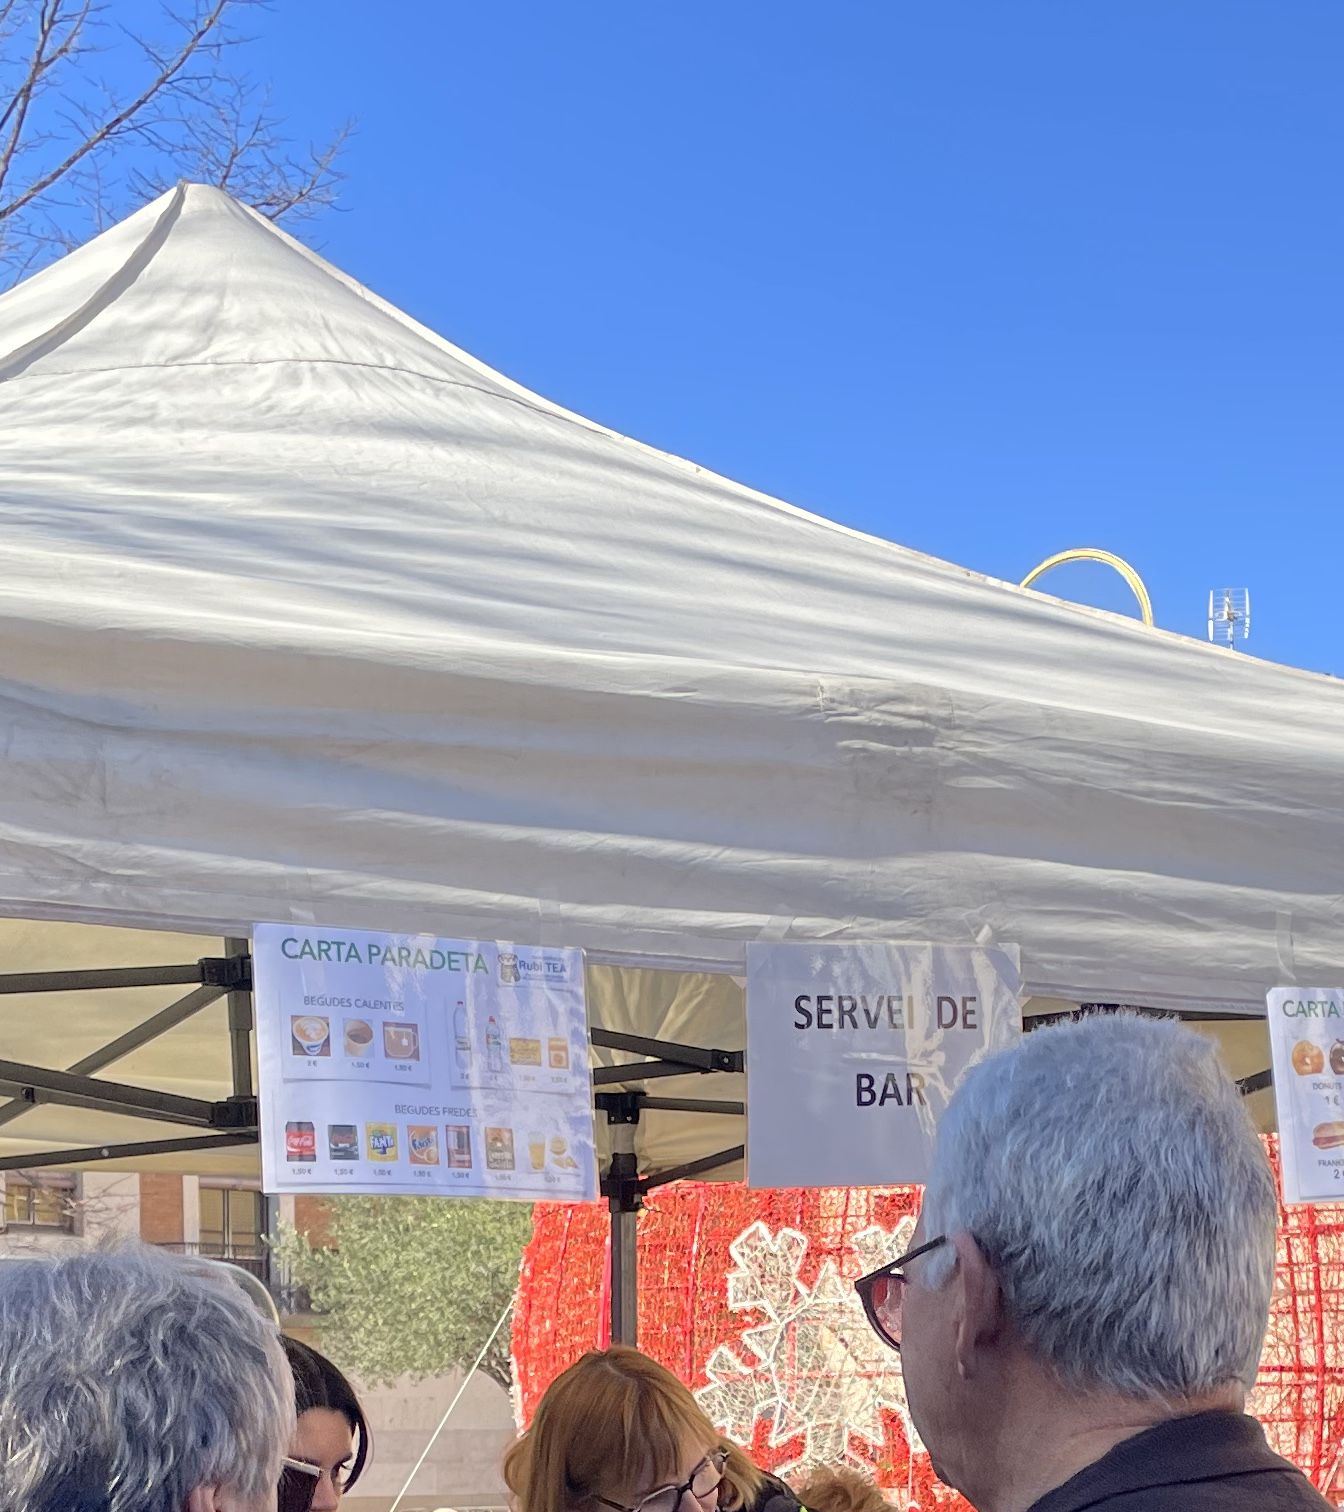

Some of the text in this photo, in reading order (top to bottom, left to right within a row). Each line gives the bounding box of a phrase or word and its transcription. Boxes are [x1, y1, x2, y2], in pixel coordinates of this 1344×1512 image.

[281, 937, 488, 975] CARTA PARADETA
[545, 962, 567, 974] TEA
[303, 995, 405, 1012] BEGUDES CALENTES
[794, 994, 978, 1030] SERVEI DE
[1282, 1000, 1341, 1018] CARTA
[855, 1072, 927, 1107] BAR
[1333, 1096, 1340, 1106] €
[394, 1104, 441, 1117] BEGUDES
[1333, 1169, 1340, 1179] 2
